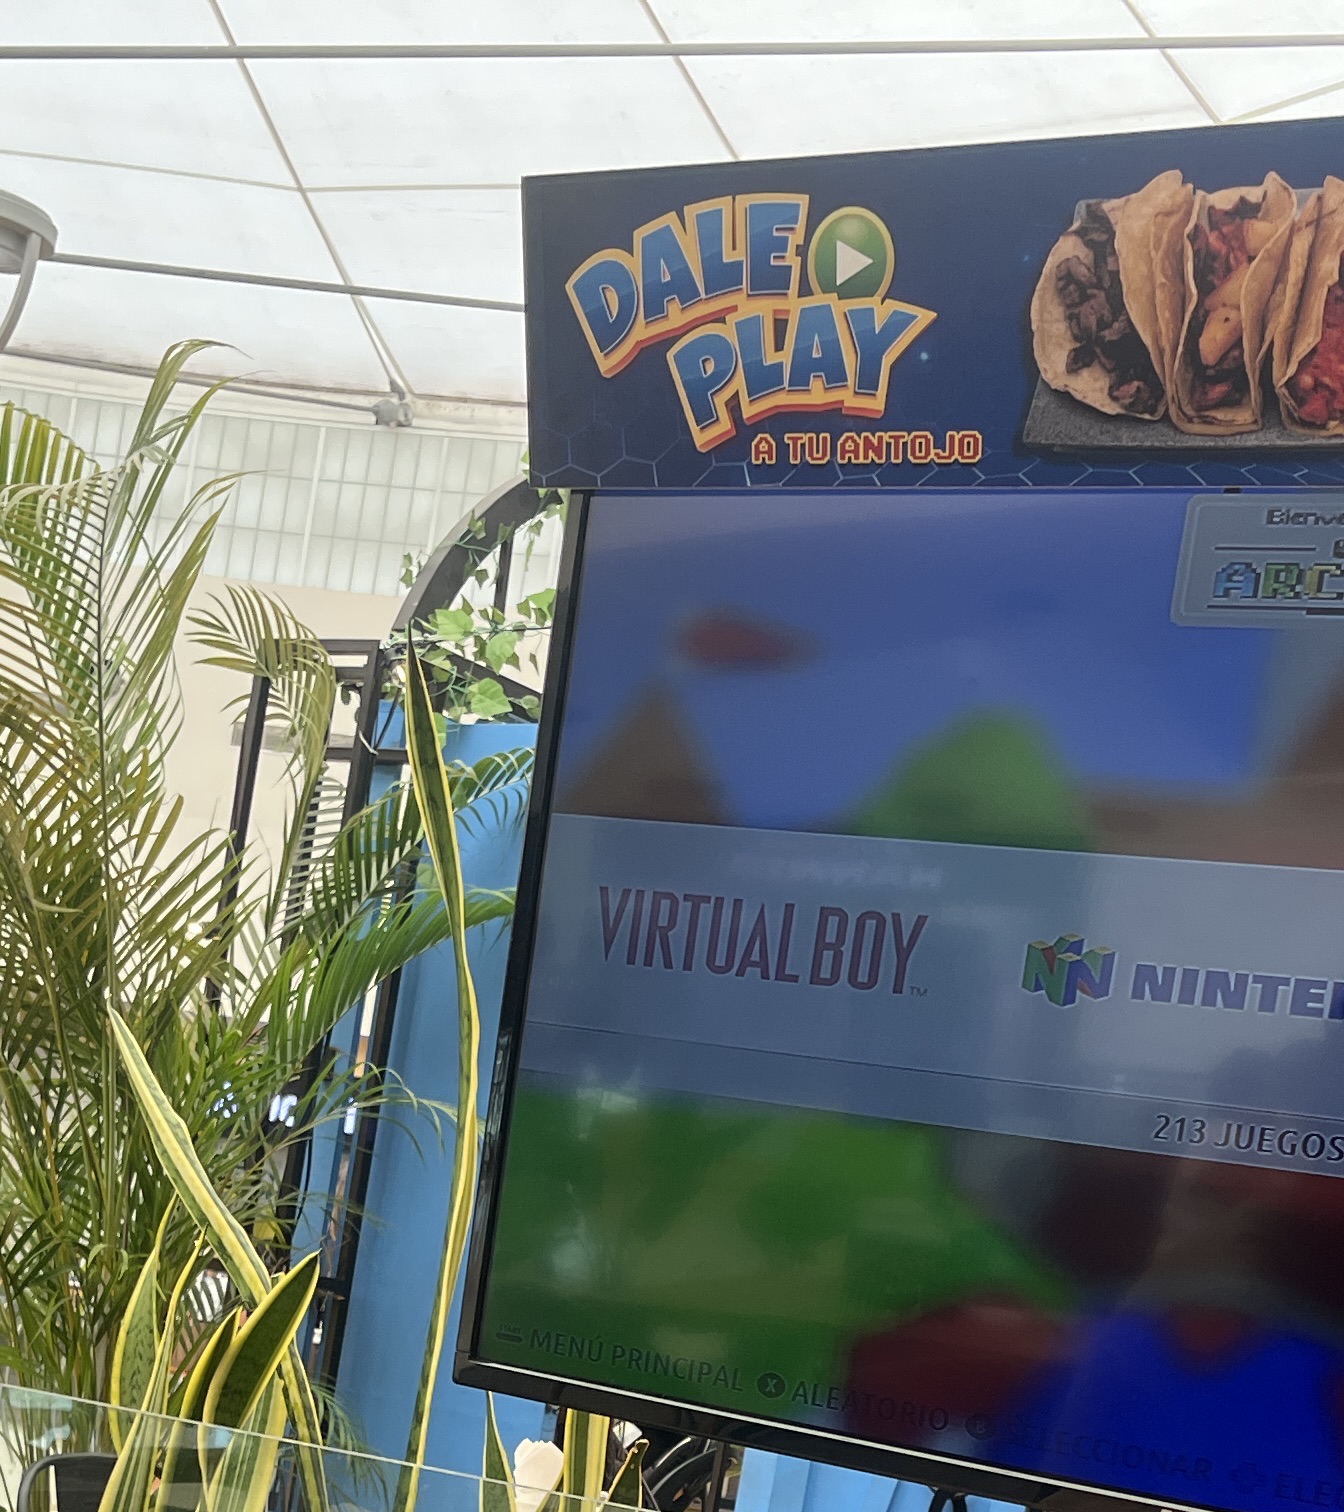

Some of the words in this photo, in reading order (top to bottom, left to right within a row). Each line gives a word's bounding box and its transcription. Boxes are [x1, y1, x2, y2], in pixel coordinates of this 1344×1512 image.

[564, 192, 809, 377] DALE
[666, 294, 937, 452] PLAY
[752, 434, 776, 465] A
[784, 433, 831, 464] TU
[837, 430, 982, 464] ANTOJO
[599, 885, 801, 984] VIRTUAL
[808, 906, 929, 995] BOY
[1154, 1113, 1207, 1146] 213
[529, 1328, 604, 1363] MENÚ
[610, 1344, 745, 1393] PRINCIPAL
[791, 1379, 951, 1432] ALEATORIO
